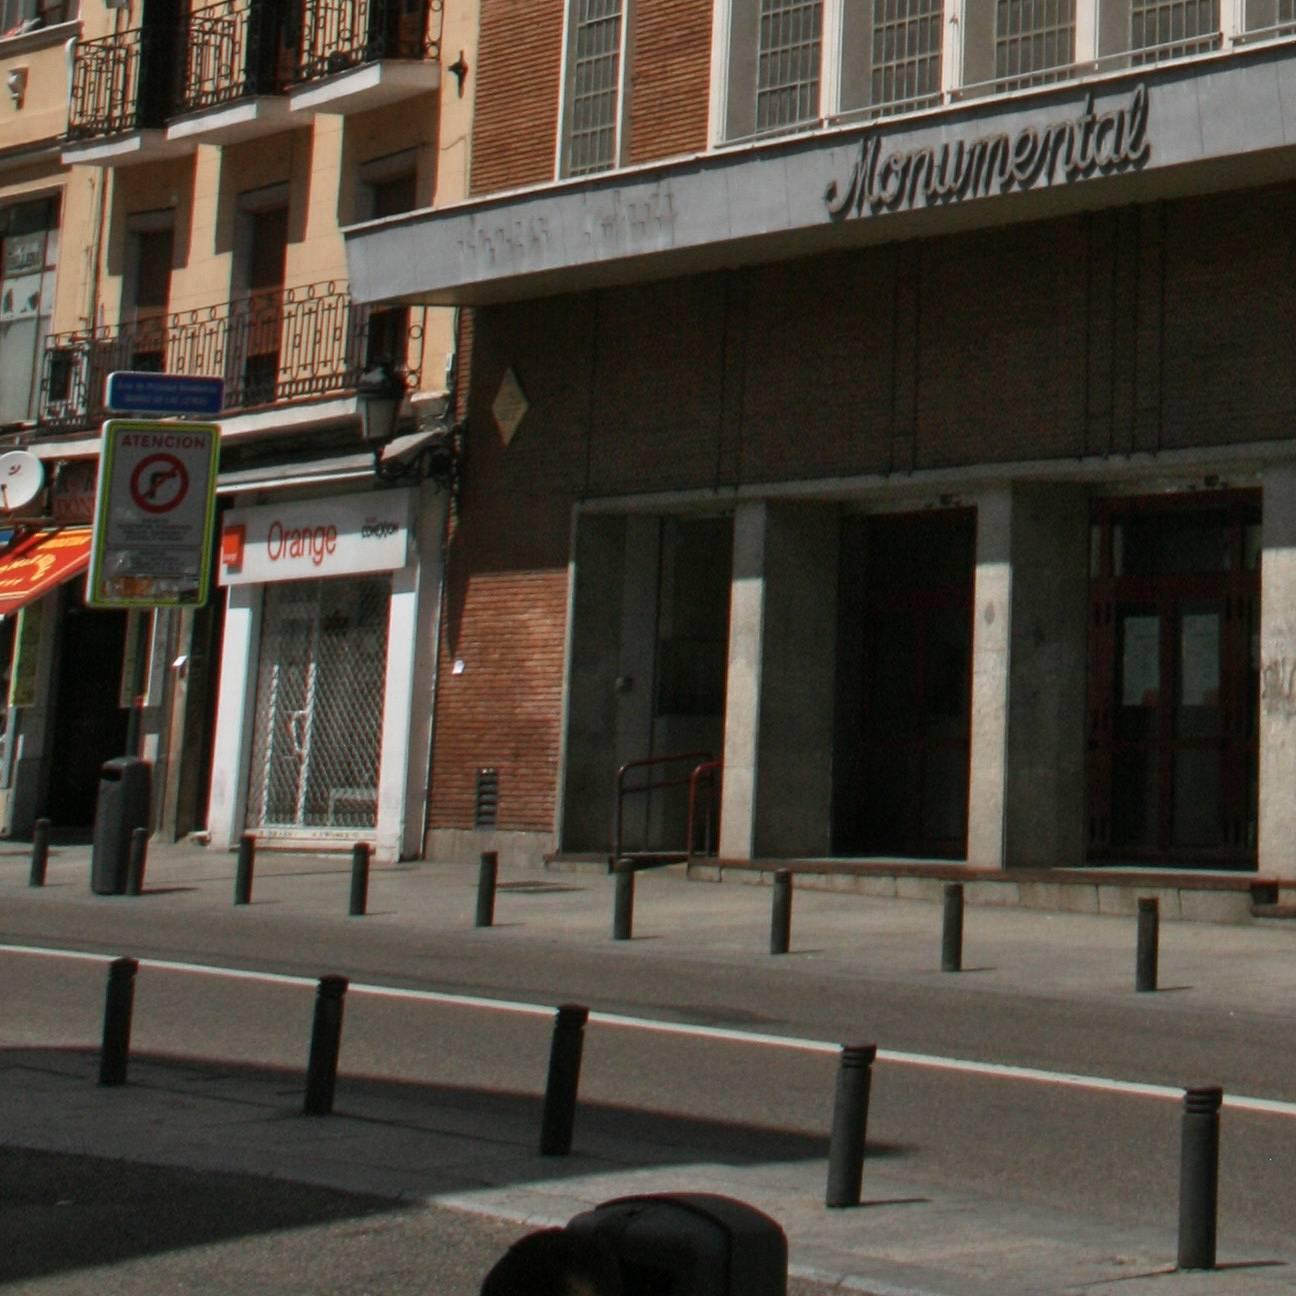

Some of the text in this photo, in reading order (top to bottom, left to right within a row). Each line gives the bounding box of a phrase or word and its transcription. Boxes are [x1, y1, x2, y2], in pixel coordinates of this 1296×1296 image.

[826, 82, 1152, 216] Monumental
[121, 433, 206, 449] ATENCION
[267, 520, 337, 566] Orange
